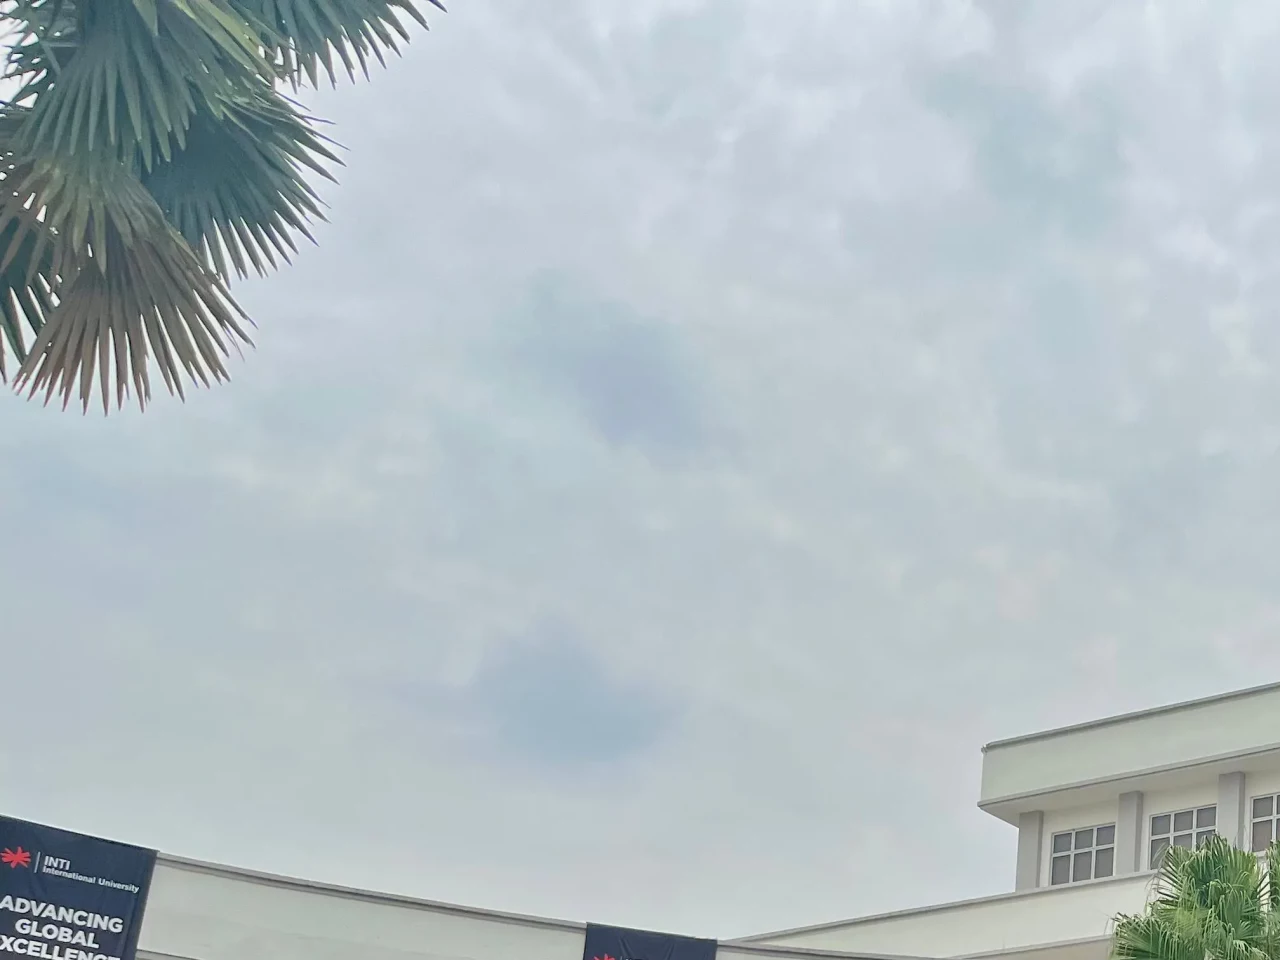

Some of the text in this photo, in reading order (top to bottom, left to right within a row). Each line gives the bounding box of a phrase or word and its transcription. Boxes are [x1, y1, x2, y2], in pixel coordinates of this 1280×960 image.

[44, 855, 71, 870] INTI
[42, 866, 140, 894] International University
[0, 895, 124, 934] ADVANCING
[15, 918, 100, 949] GLOBAL
